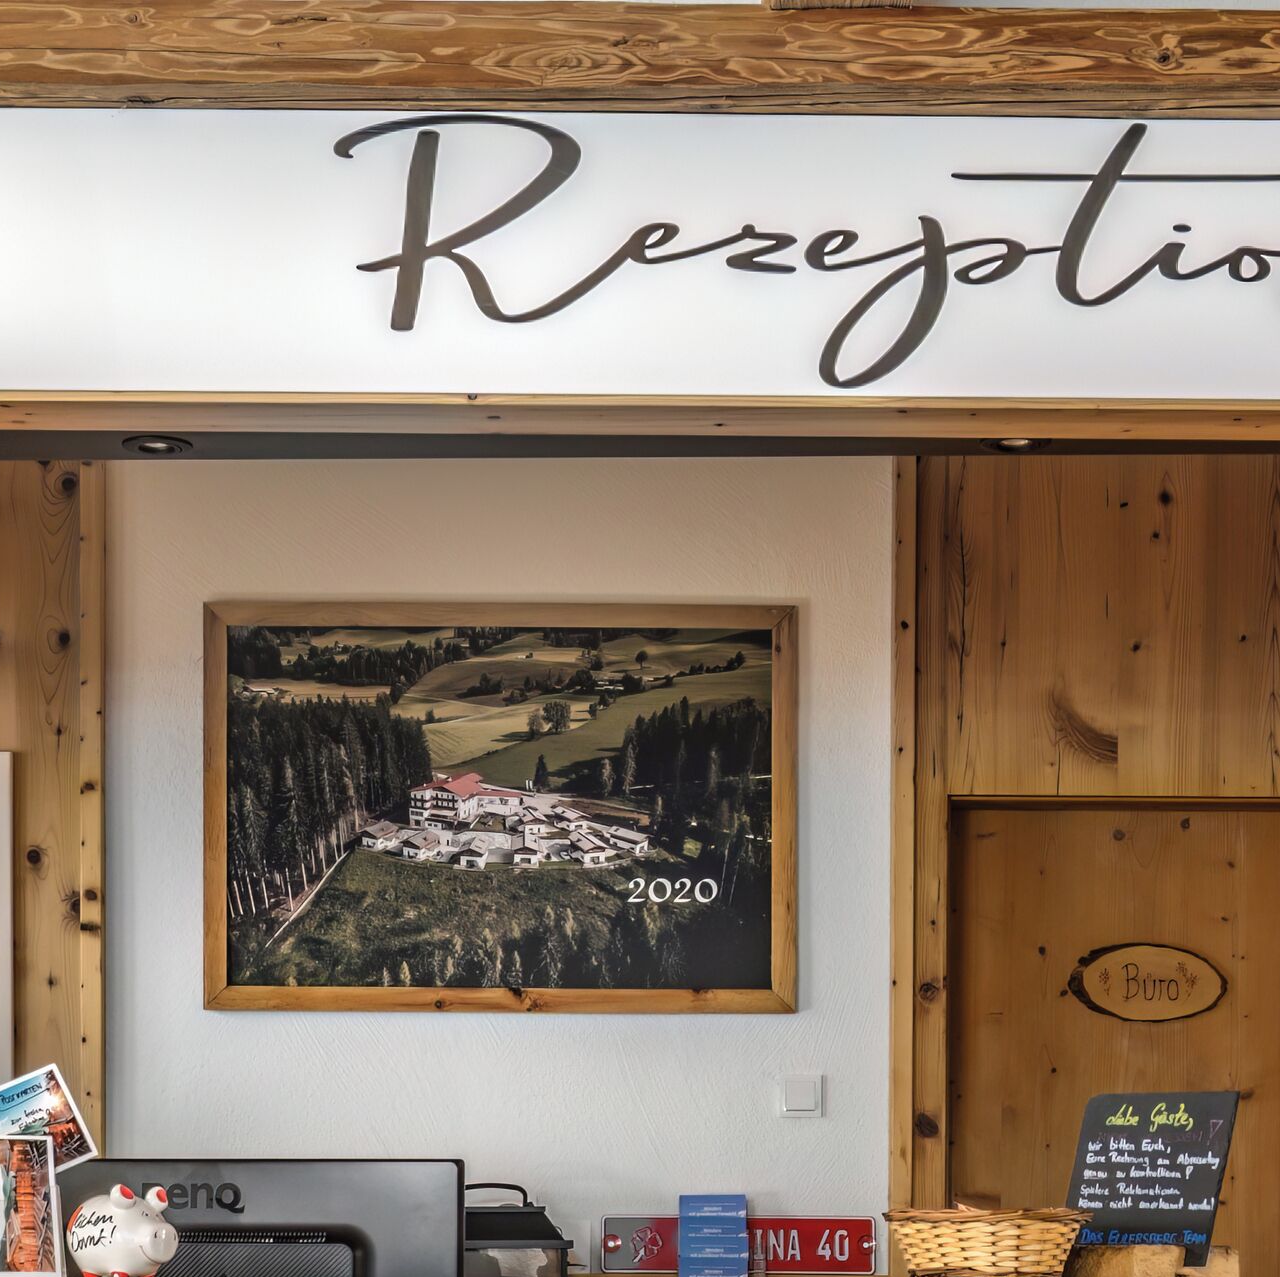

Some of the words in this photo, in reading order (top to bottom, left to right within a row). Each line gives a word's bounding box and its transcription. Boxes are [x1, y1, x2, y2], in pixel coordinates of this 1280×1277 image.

[627, 877, 718, 903] 2020
[1122, 962, 1180, 1001] Büro
[1149, 1102, 1193, 1132] Gäste,
[1109, 1136, 1135, 1151] bitten
[1141, 1137, 1171, 1154] Euch,
[1108, 1151, 1150, 1167] Rechnung
[1109, 1196, 1133, 1209] nicht
[816, 1229, 849, 1262] 40
[1079, 1228, 1105, 1244] DAS
[1183, 1229, 1207, 1245] TEAM
